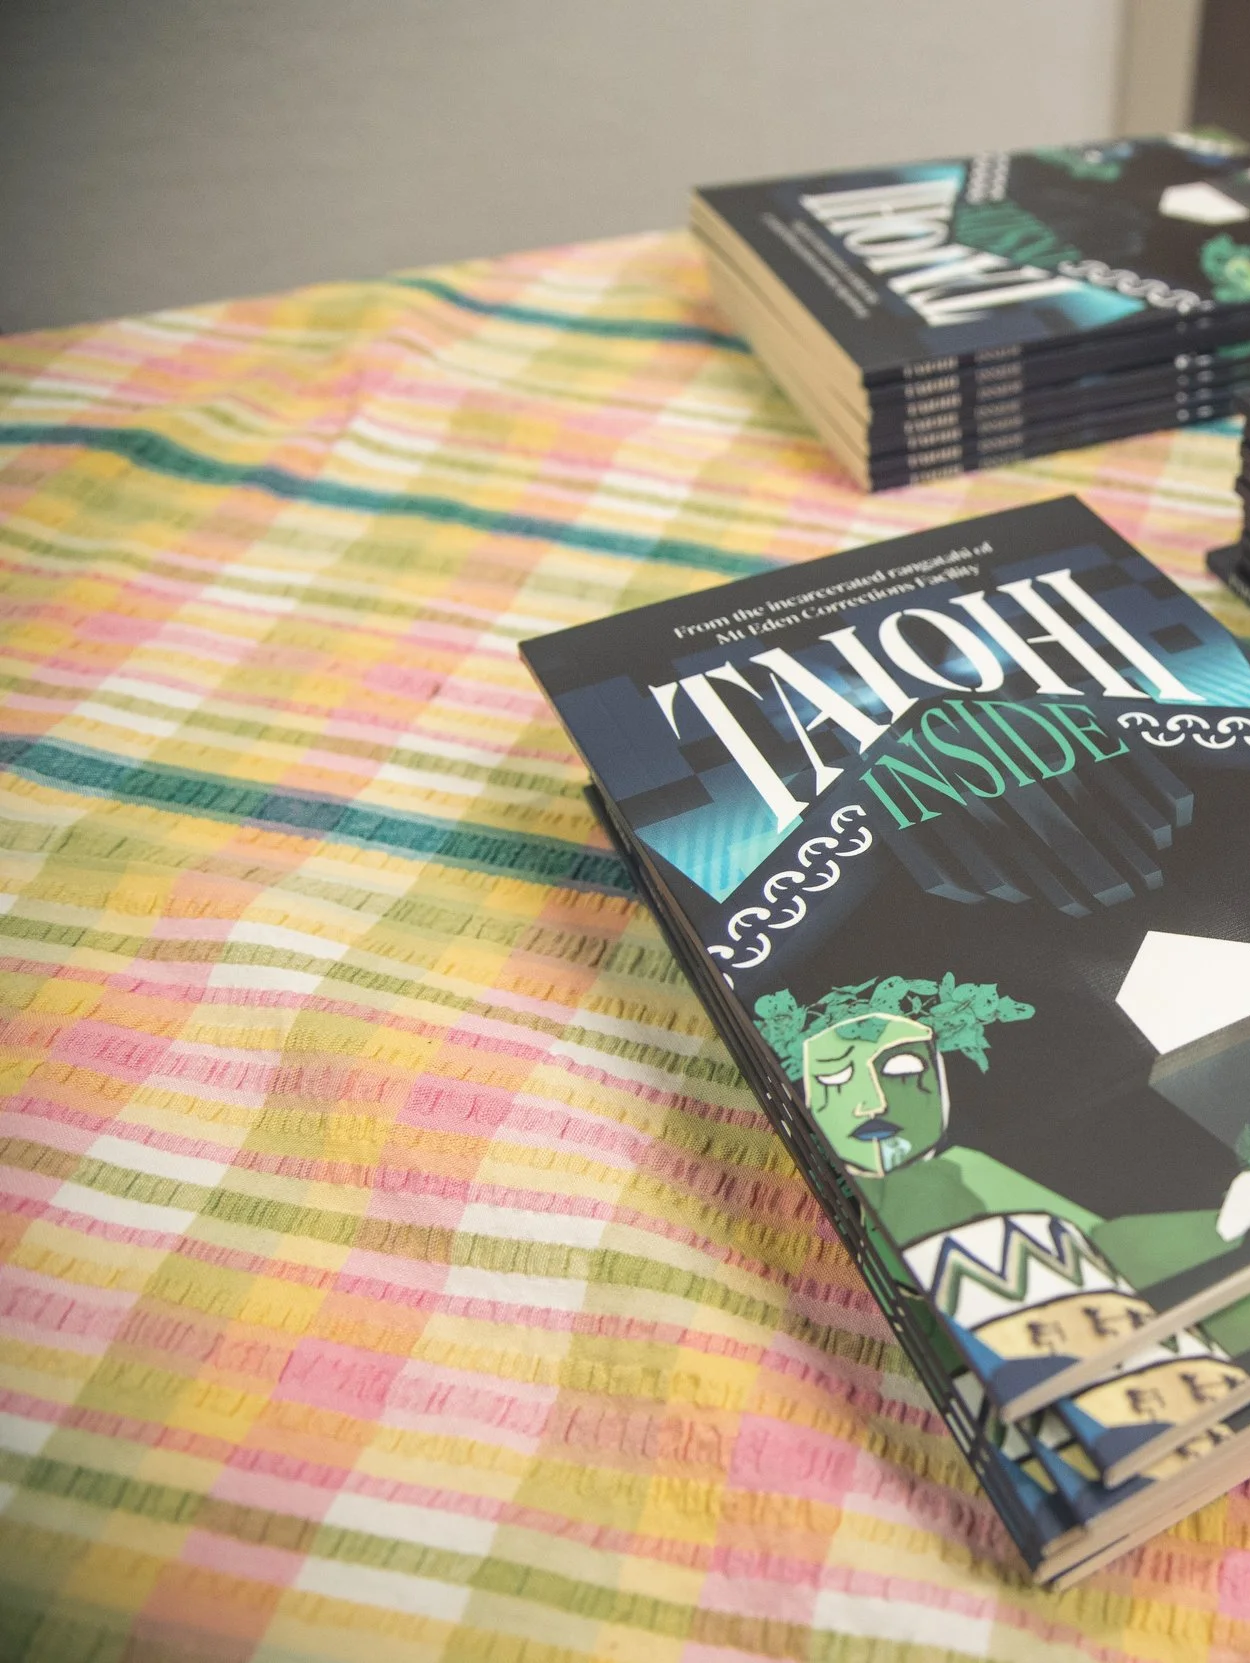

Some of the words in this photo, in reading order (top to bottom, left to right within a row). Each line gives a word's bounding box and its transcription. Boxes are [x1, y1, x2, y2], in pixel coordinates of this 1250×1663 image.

[673, 616, 730, 639] From
[731, 608, 765, 622] the
[765, 569, 886, 612] incarcerated
[715, 628, 746, 645] Mt
[747, 613, 801, 636] Eden
[801, 582, 915, 620] Corrections
[647, 568, 1207, 834] TAIOHI
[859, 698, 1130, 831] INSIDE
